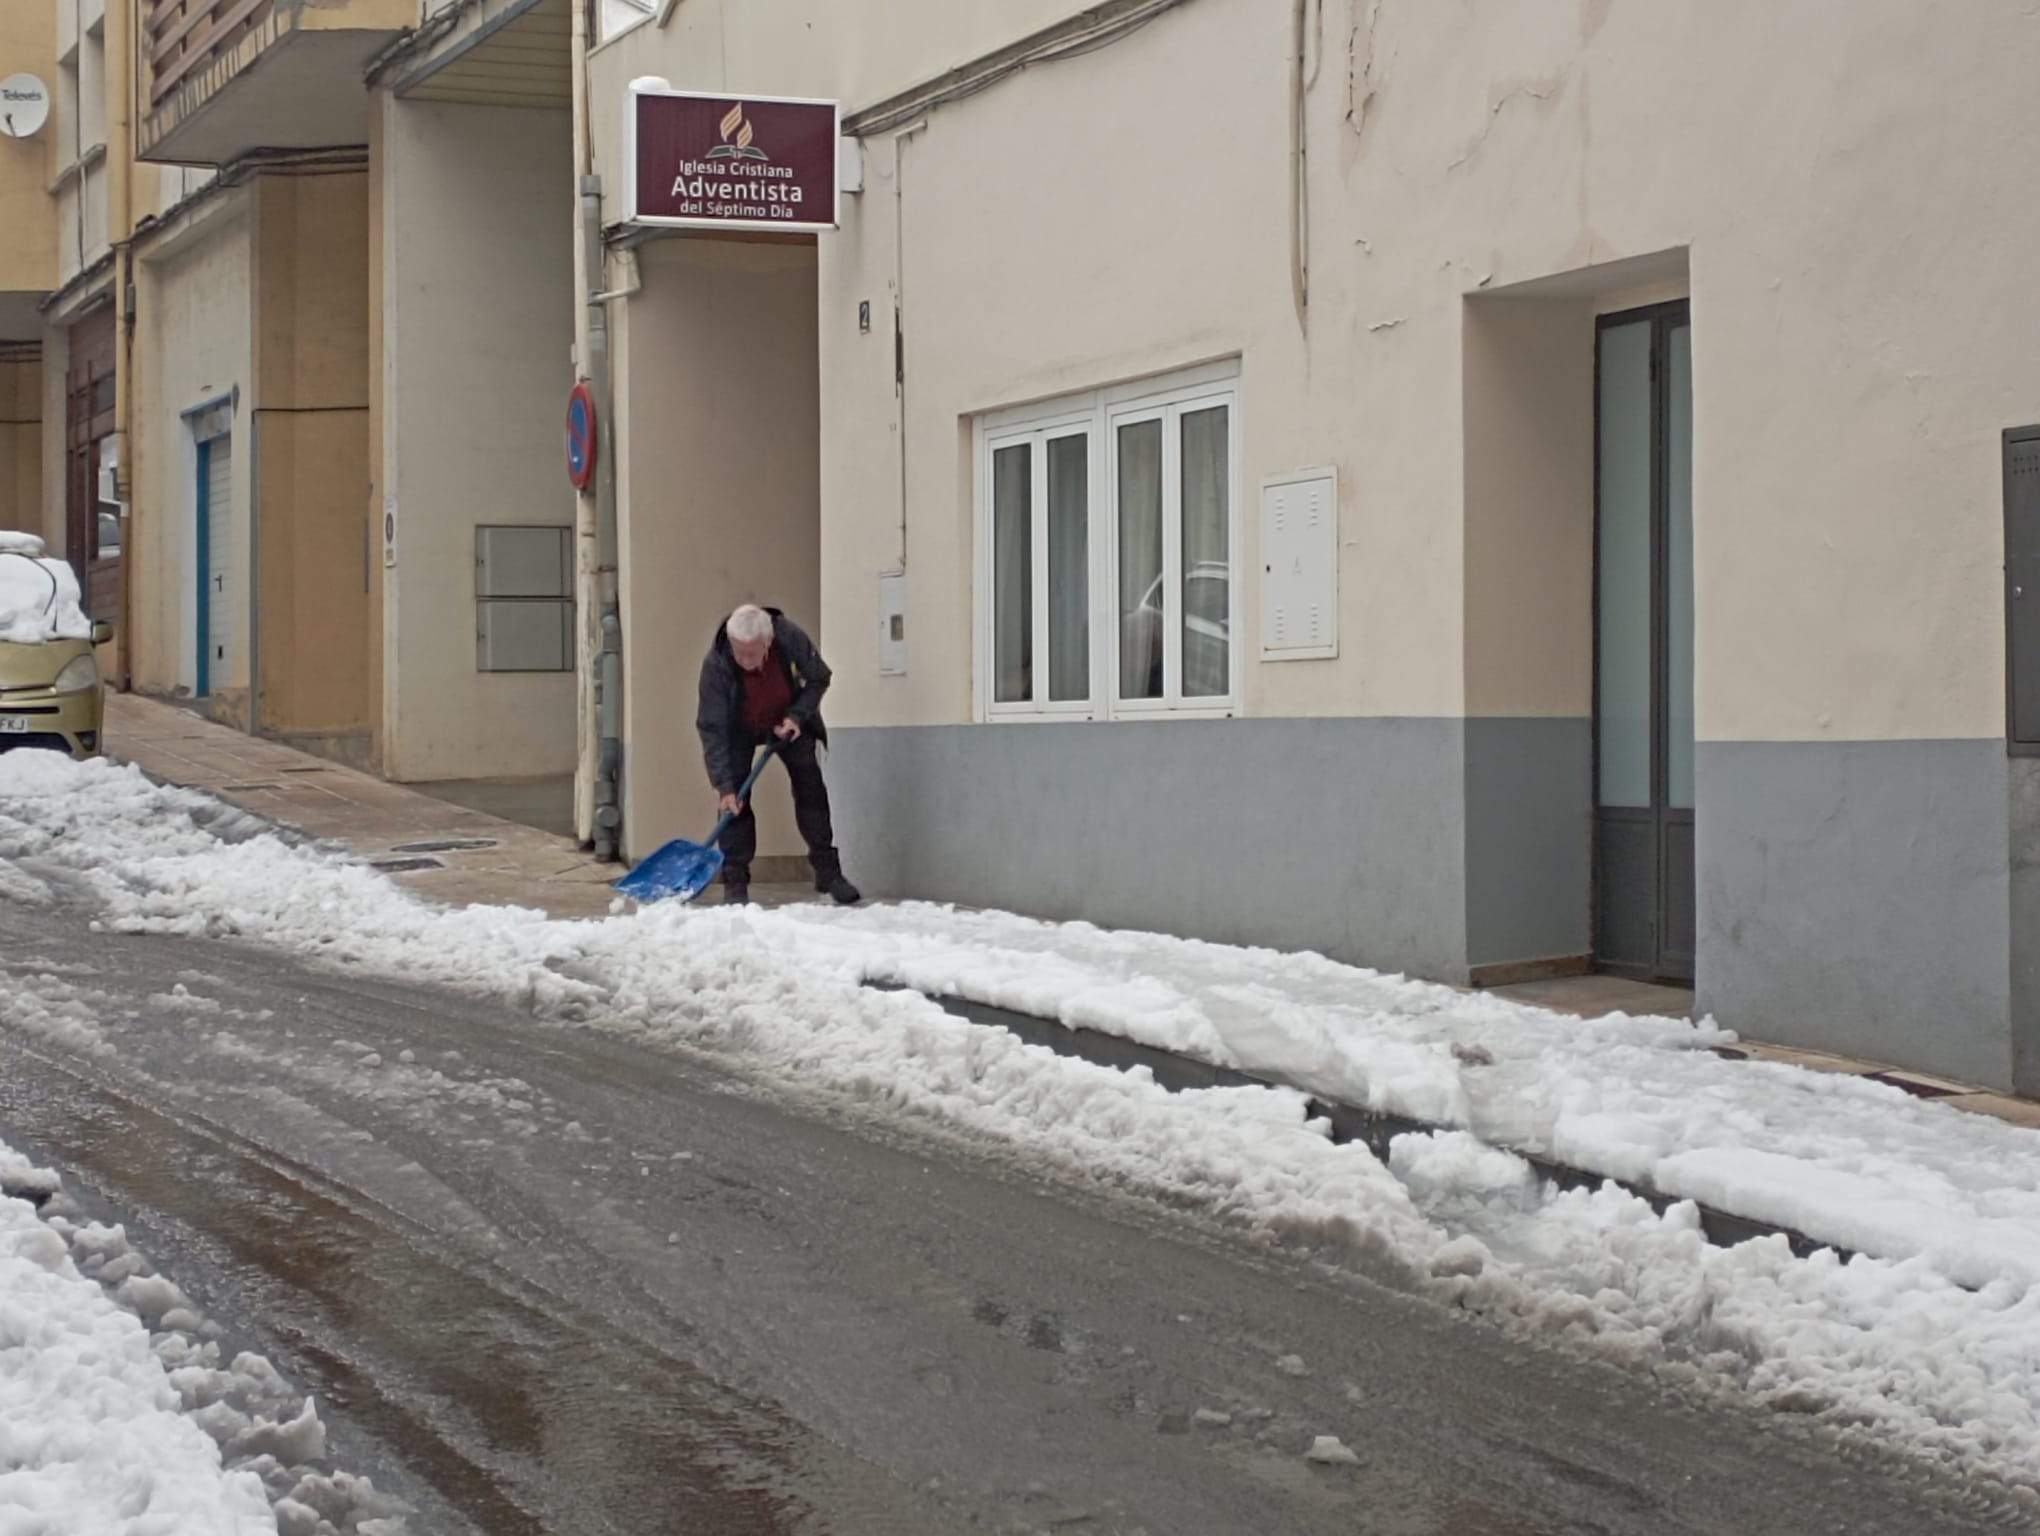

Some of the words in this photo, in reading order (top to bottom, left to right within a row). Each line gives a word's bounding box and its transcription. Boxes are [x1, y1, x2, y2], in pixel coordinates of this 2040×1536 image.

[680, 159, 725, 175] Iglesia
[730, 162, 793, 178] Cristiana
[671, 175, 803, 203] Adventista
[680, 199, 702, 214] del
[707, 201, 766, 218] Séptimo
[770, 203, 793, 218] Día
